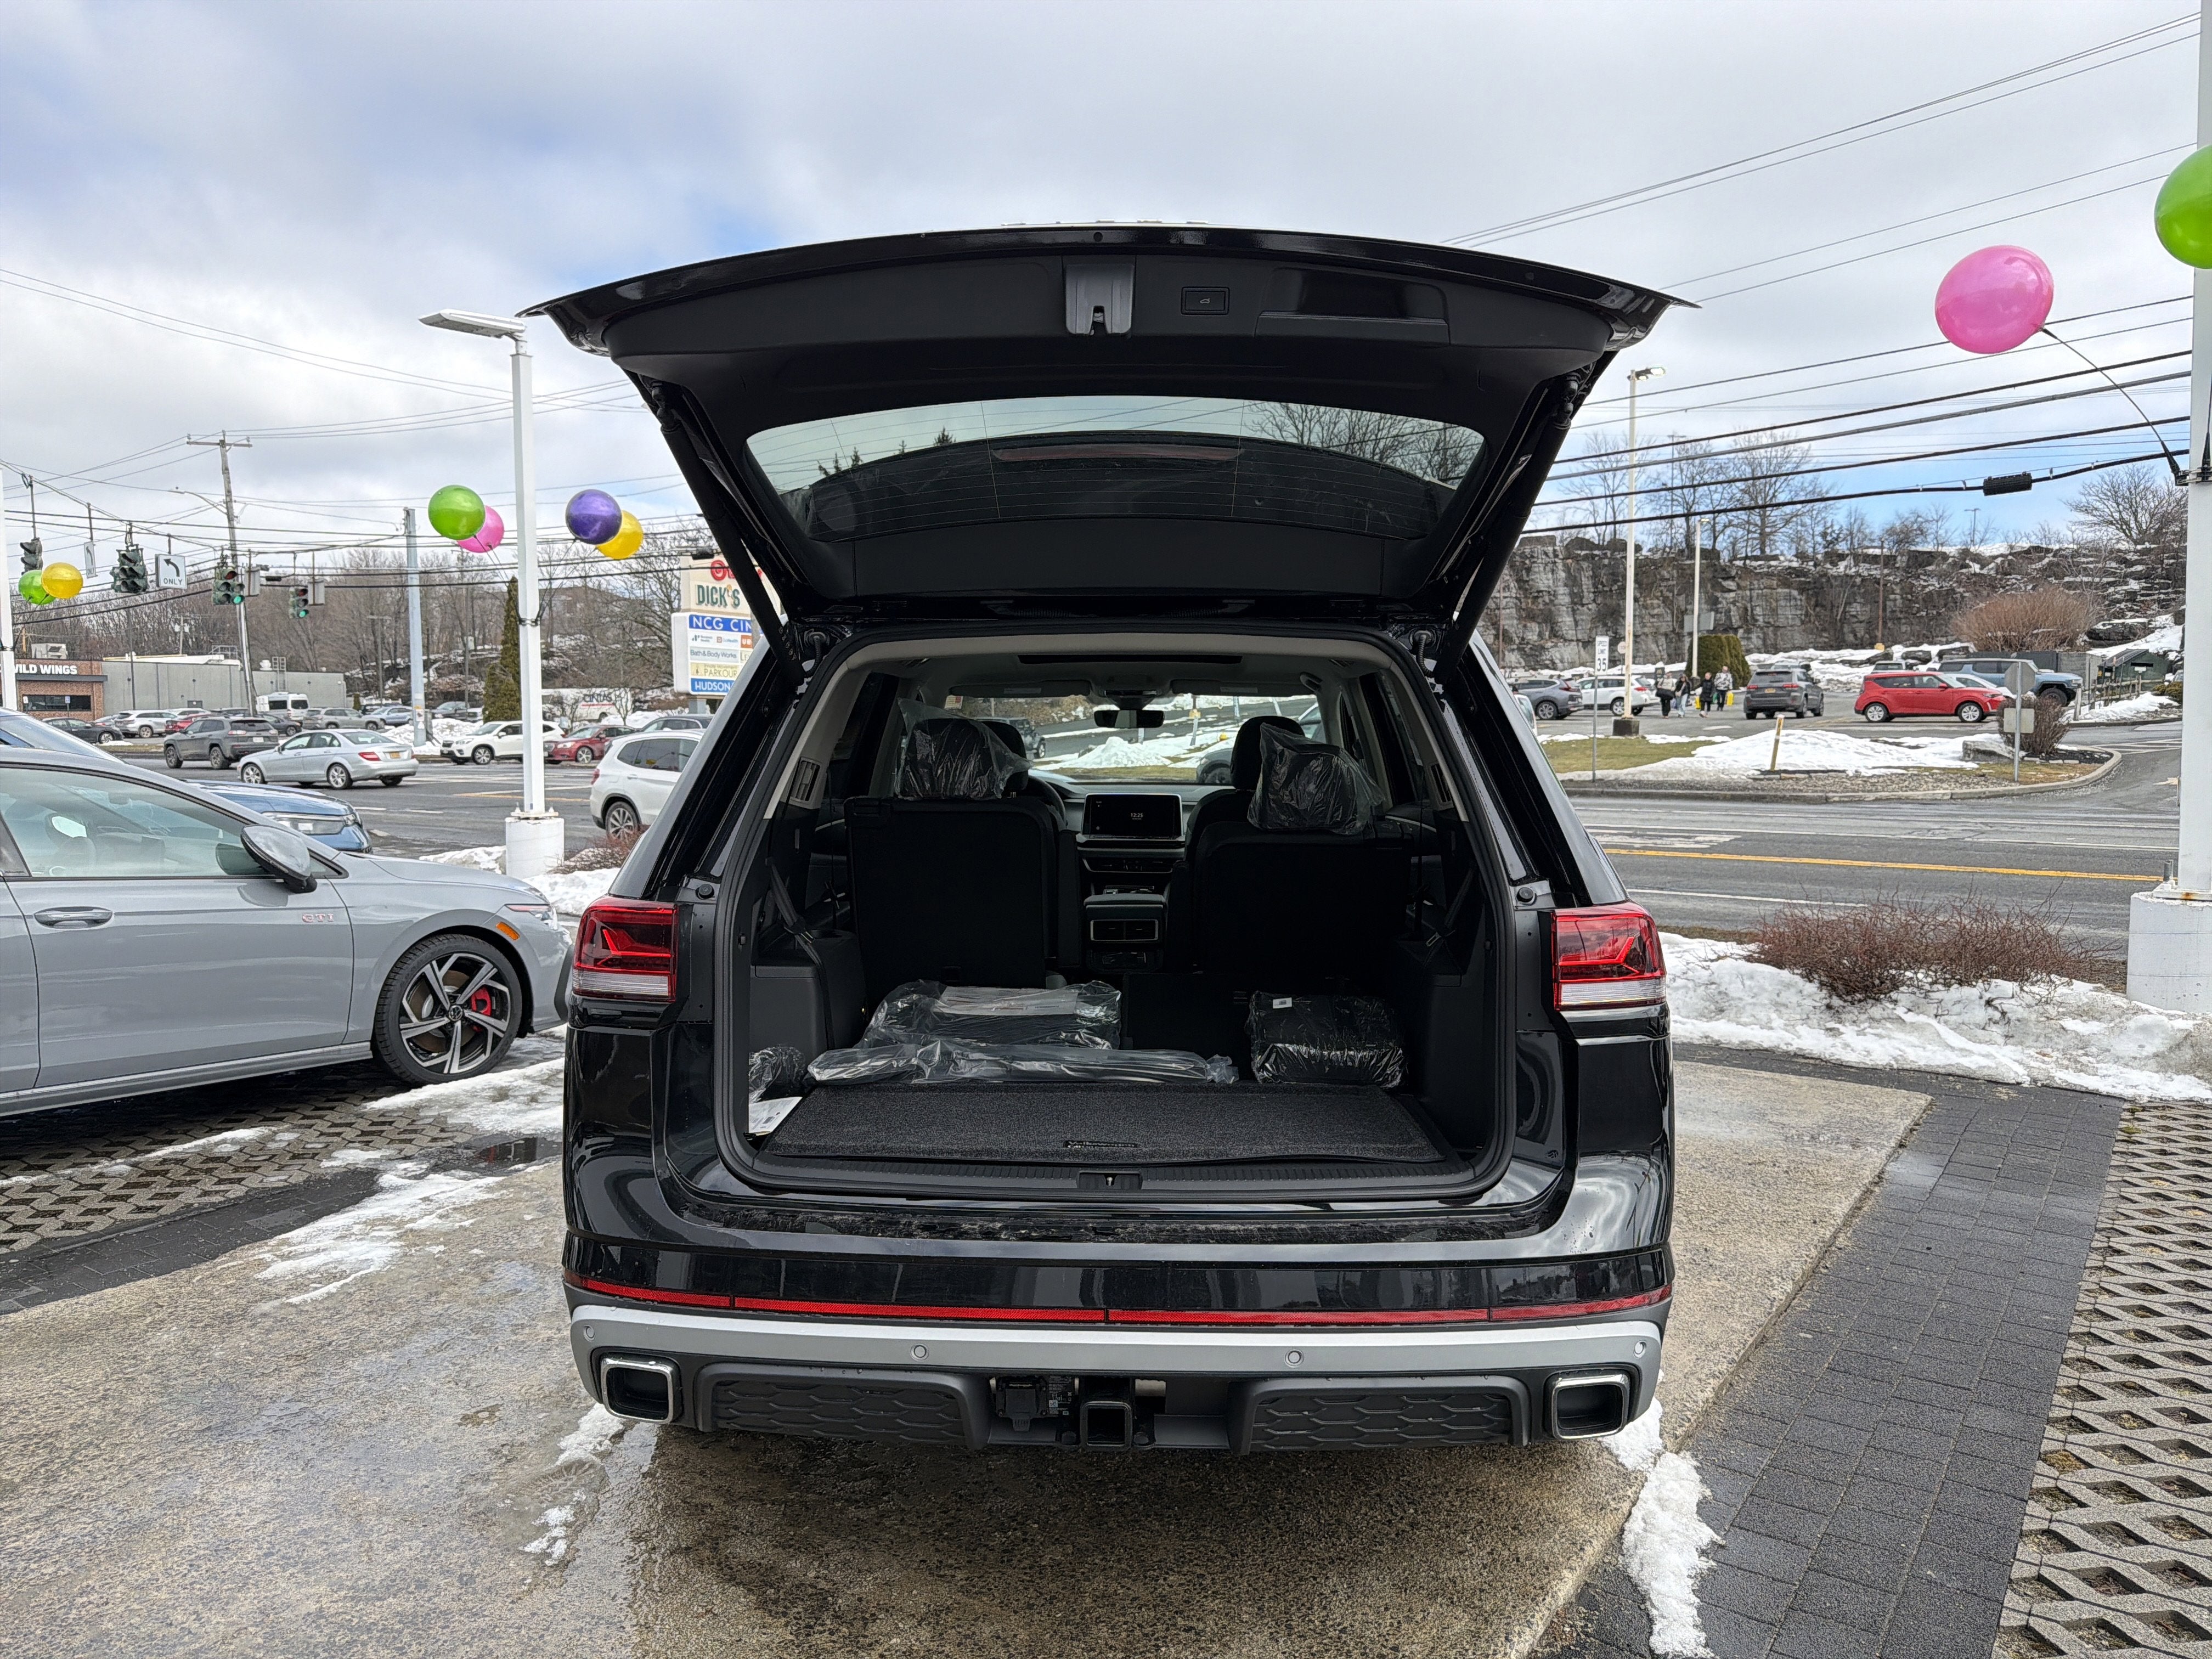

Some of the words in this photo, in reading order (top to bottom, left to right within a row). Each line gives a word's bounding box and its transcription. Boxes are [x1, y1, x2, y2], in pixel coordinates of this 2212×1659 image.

[697, 584, 740, 607] DICK'S
[693, 616, 724, 630] NCG
[40, 664, 77, 675] WINGS
[1597, 658, 1606, 672] 35
[704, 668, 737, 678] PARKOUR
[695, 681, 731, 691] HUDSON
[302, 913, 334, 923] GTI
